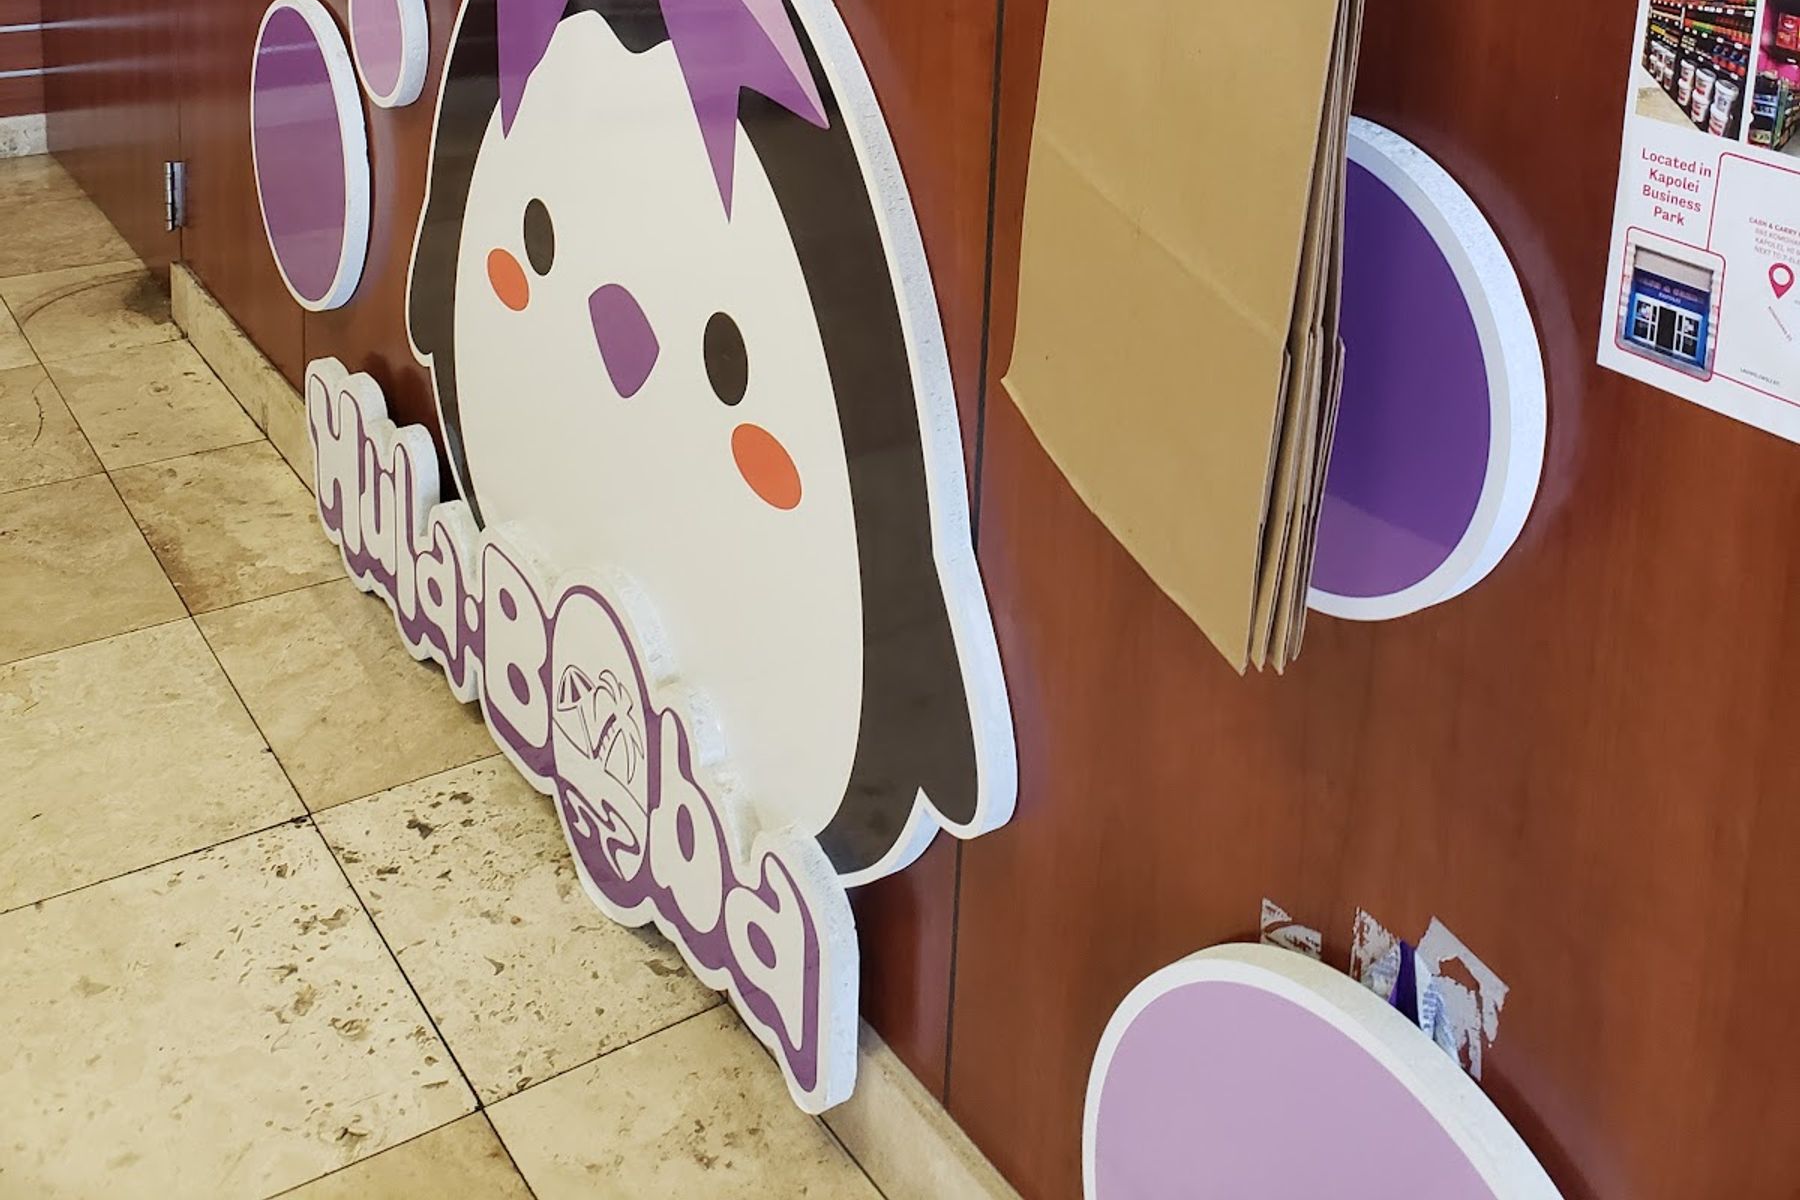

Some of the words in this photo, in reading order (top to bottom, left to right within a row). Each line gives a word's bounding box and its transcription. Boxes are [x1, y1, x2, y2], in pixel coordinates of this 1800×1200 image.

[1642, 147, 1696, 174] Located
[1699, 162, 1713, 178] in
[1648, 167, 1701, 193] Kapolei
[1642, 184, 1702, 213] Business
[1653, 205, 1686, 227] Park
